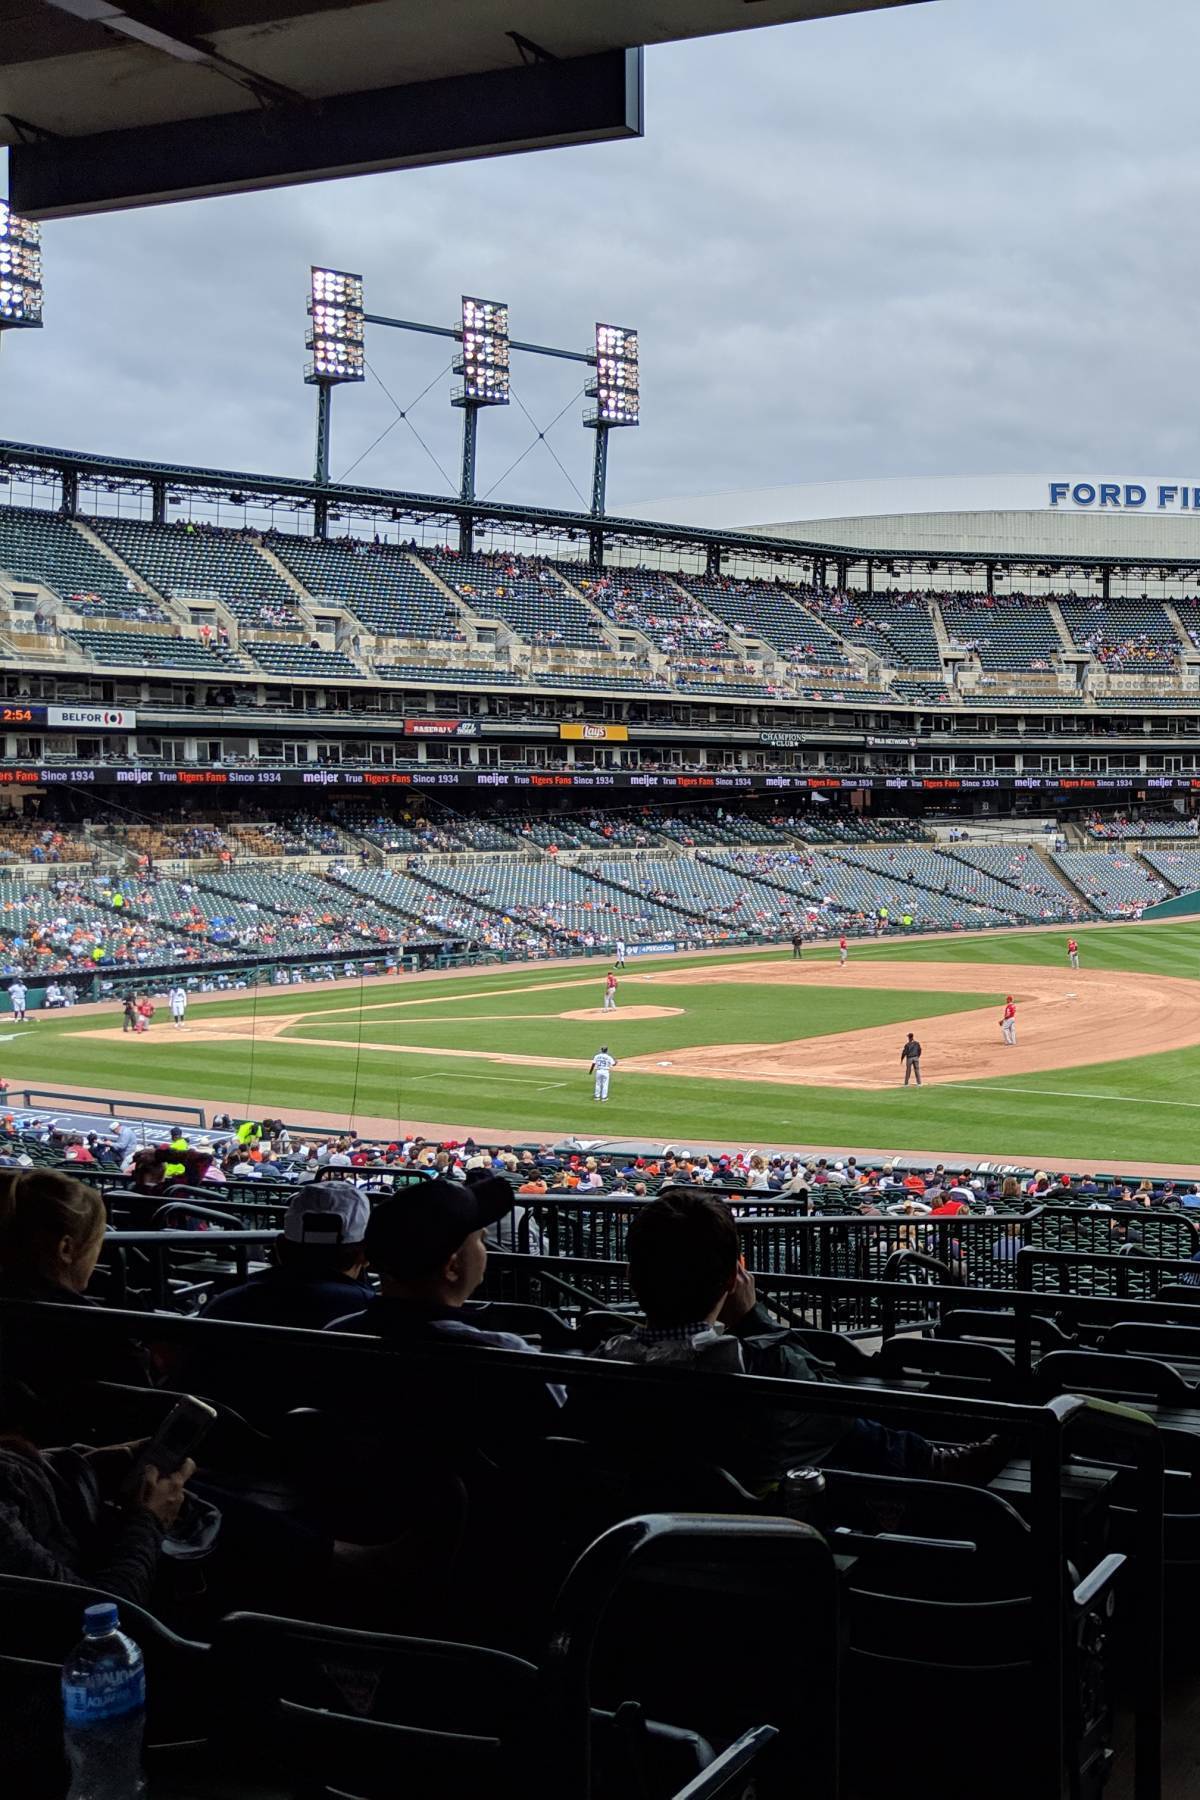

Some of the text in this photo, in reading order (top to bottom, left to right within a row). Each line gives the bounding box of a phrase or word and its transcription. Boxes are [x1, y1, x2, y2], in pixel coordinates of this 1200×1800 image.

[1048, 482, 1147, 507] FORD
[4, 710, 32, 721] 2:54
[62, 713, 101, 722] BELFOR
[761, 732, 806, 742] CHAMPIONS
[15, 770, 94, 781] Fans Since 1934
[117, 770, 281, 784] meijer True Tigers Fans Since 1934
[304, 771, 459, 785] meijer True Tigers Fans Since 1934
[478, 773, 614, 786] meijer True Tigers Fans Since 1934
[631, 775, 658, 787] meijer
[678, 777, 697, 787] Tigers
[716, 778, 733, 786] Since
[735, 778, 751, 786] 1934
[886, 778, 908, 789] meijer
[923, 779, 943, 788] Tigers
[945, 779, 960, 787] Fans
[1148, 778, 1173, 788] meijer
